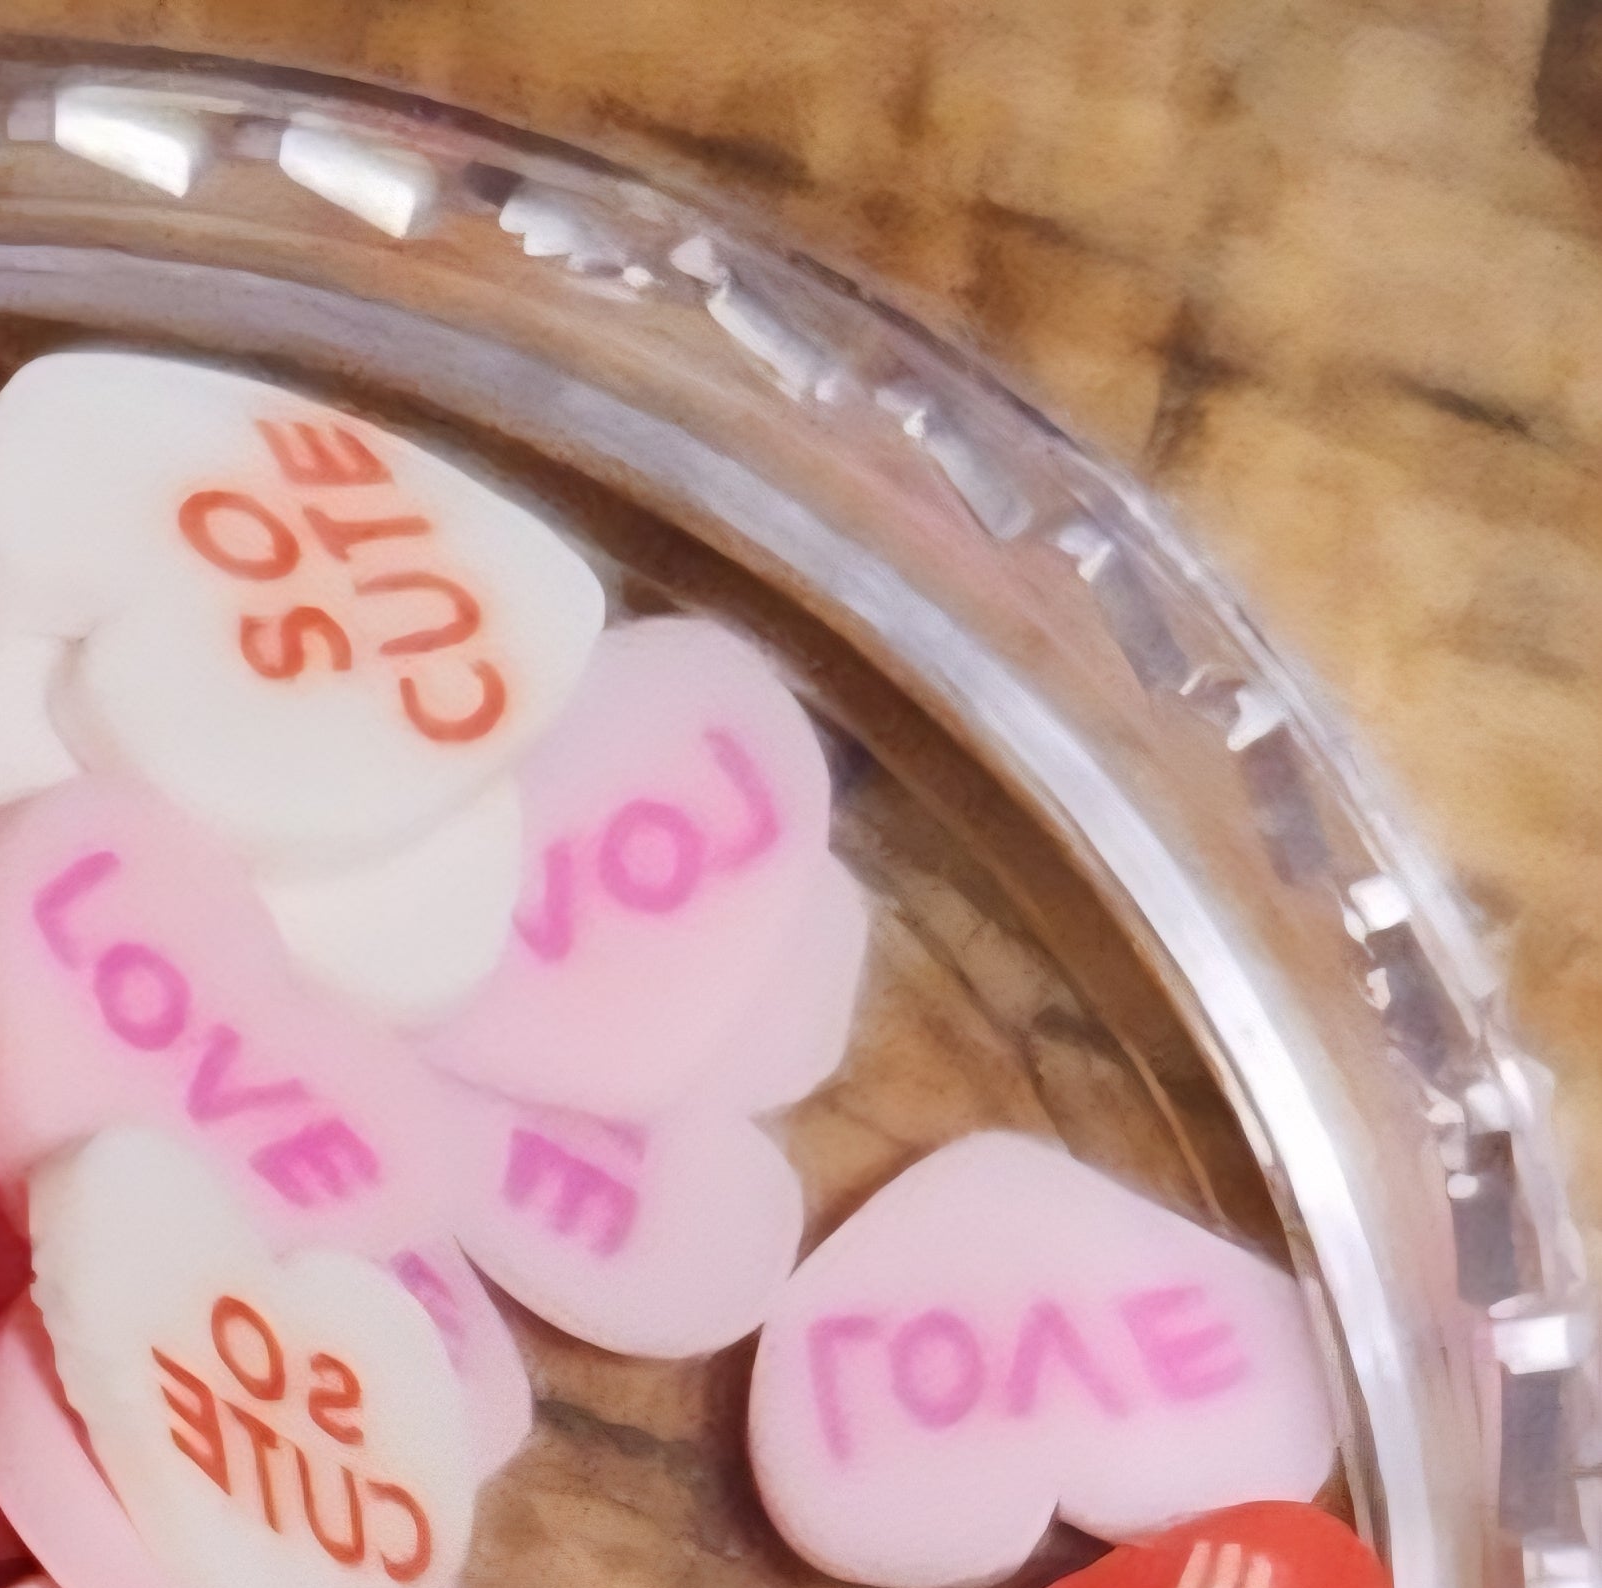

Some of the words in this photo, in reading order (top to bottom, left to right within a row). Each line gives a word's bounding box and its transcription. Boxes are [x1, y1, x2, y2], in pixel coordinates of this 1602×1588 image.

[176, 488, 353, 680] SO
[254, 418, 507, 744] CUTE
[32, 850, 382, 1210] LOVE
